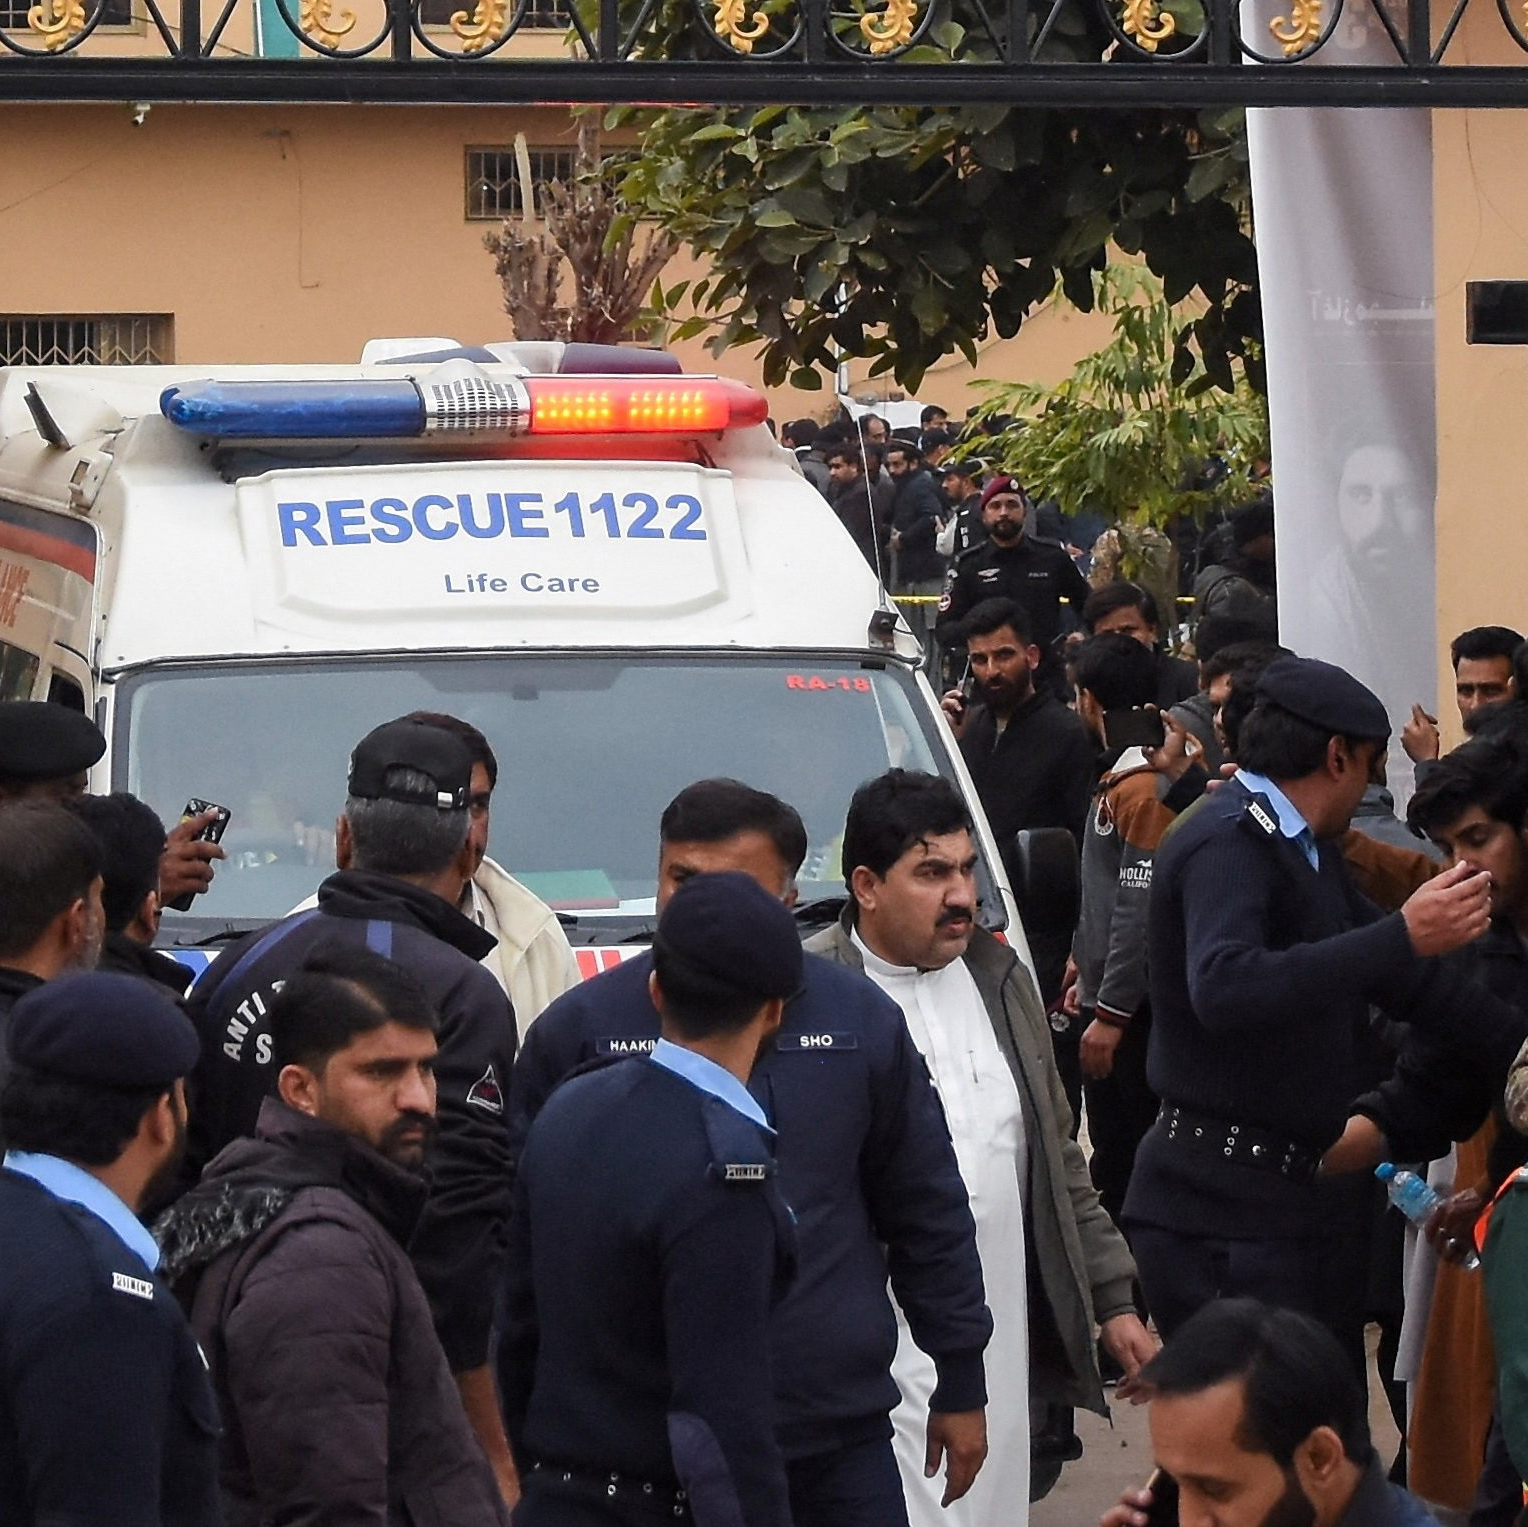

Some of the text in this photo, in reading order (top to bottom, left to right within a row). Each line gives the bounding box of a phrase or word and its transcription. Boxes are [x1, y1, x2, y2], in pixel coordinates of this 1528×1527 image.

[277, 492, 708, 547] RESCUE 1122
[444, 573, 600, 593] Life Care
[786, 674, 870, 692] RA-18
[222, 991, 266, 1062] ANTI
[799, 1035, 833, 1047] SHO
